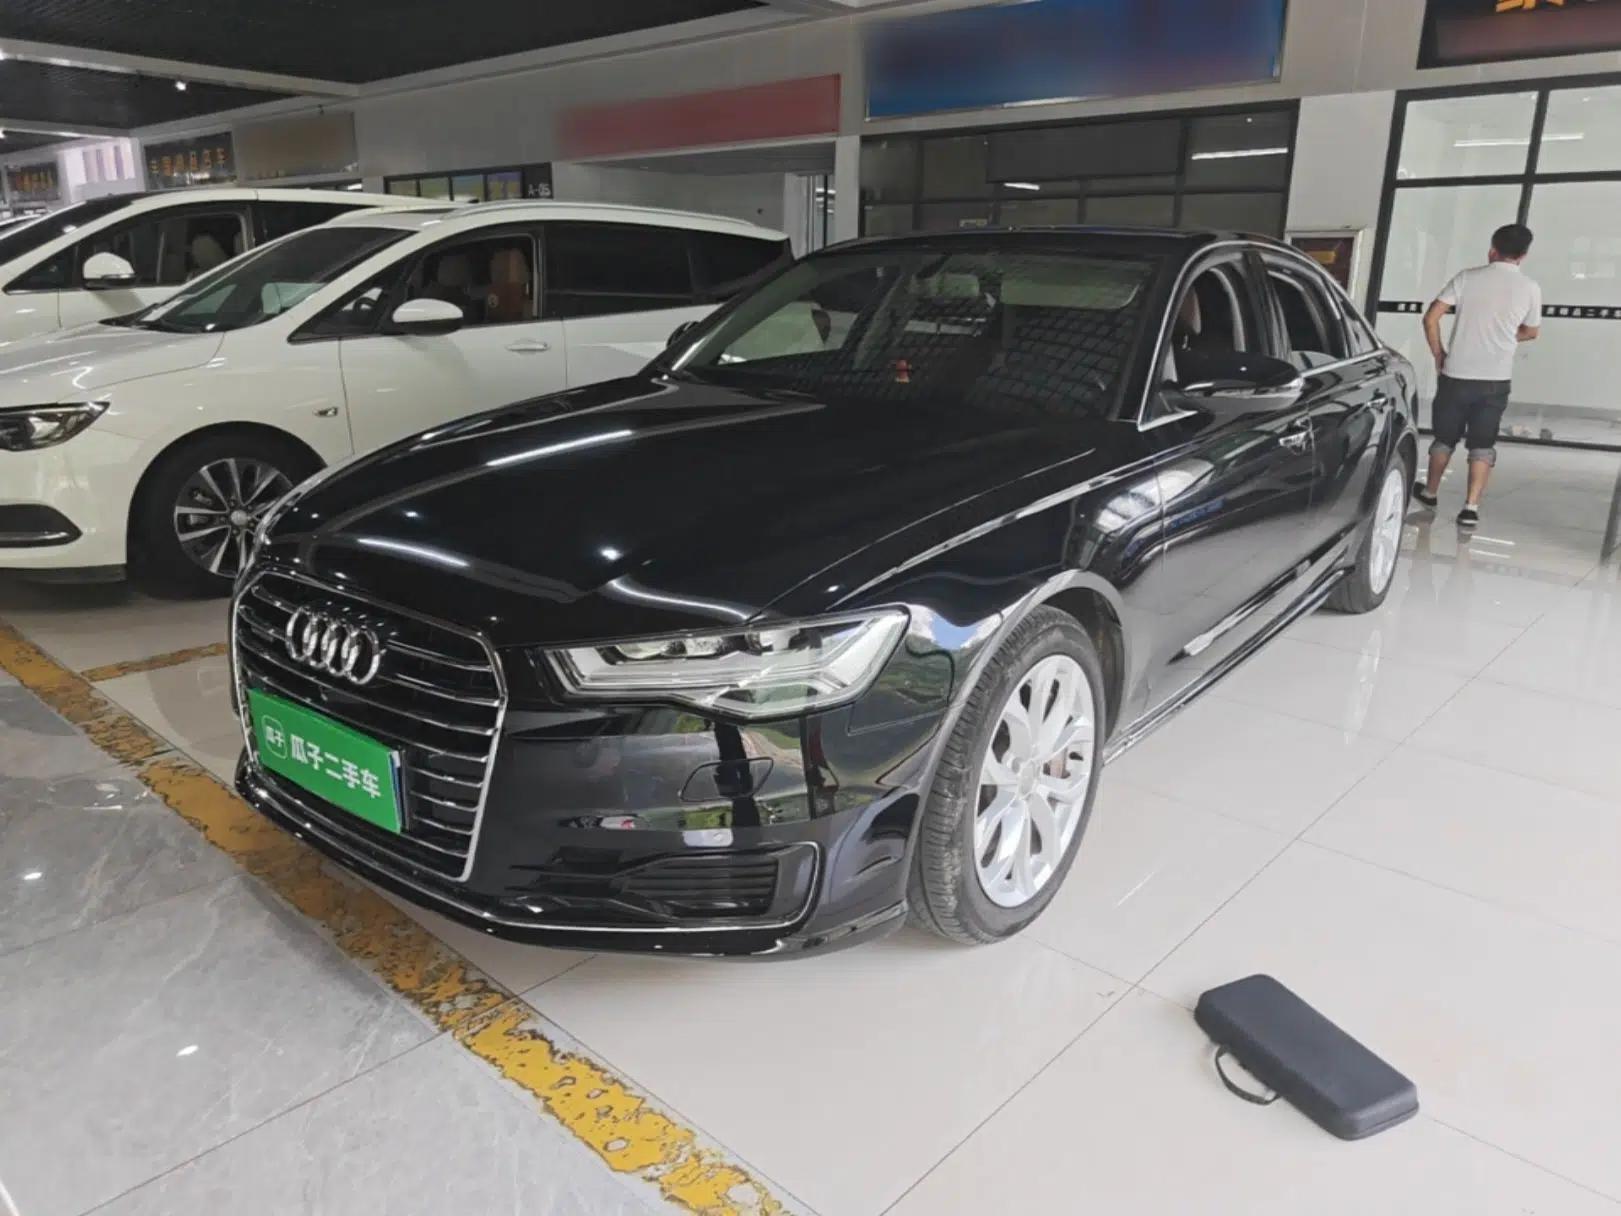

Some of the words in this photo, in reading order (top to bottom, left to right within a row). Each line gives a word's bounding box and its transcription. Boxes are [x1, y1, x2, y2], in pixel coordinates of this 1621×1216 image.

[290, 733, 382, 799] 瓜子二手车
